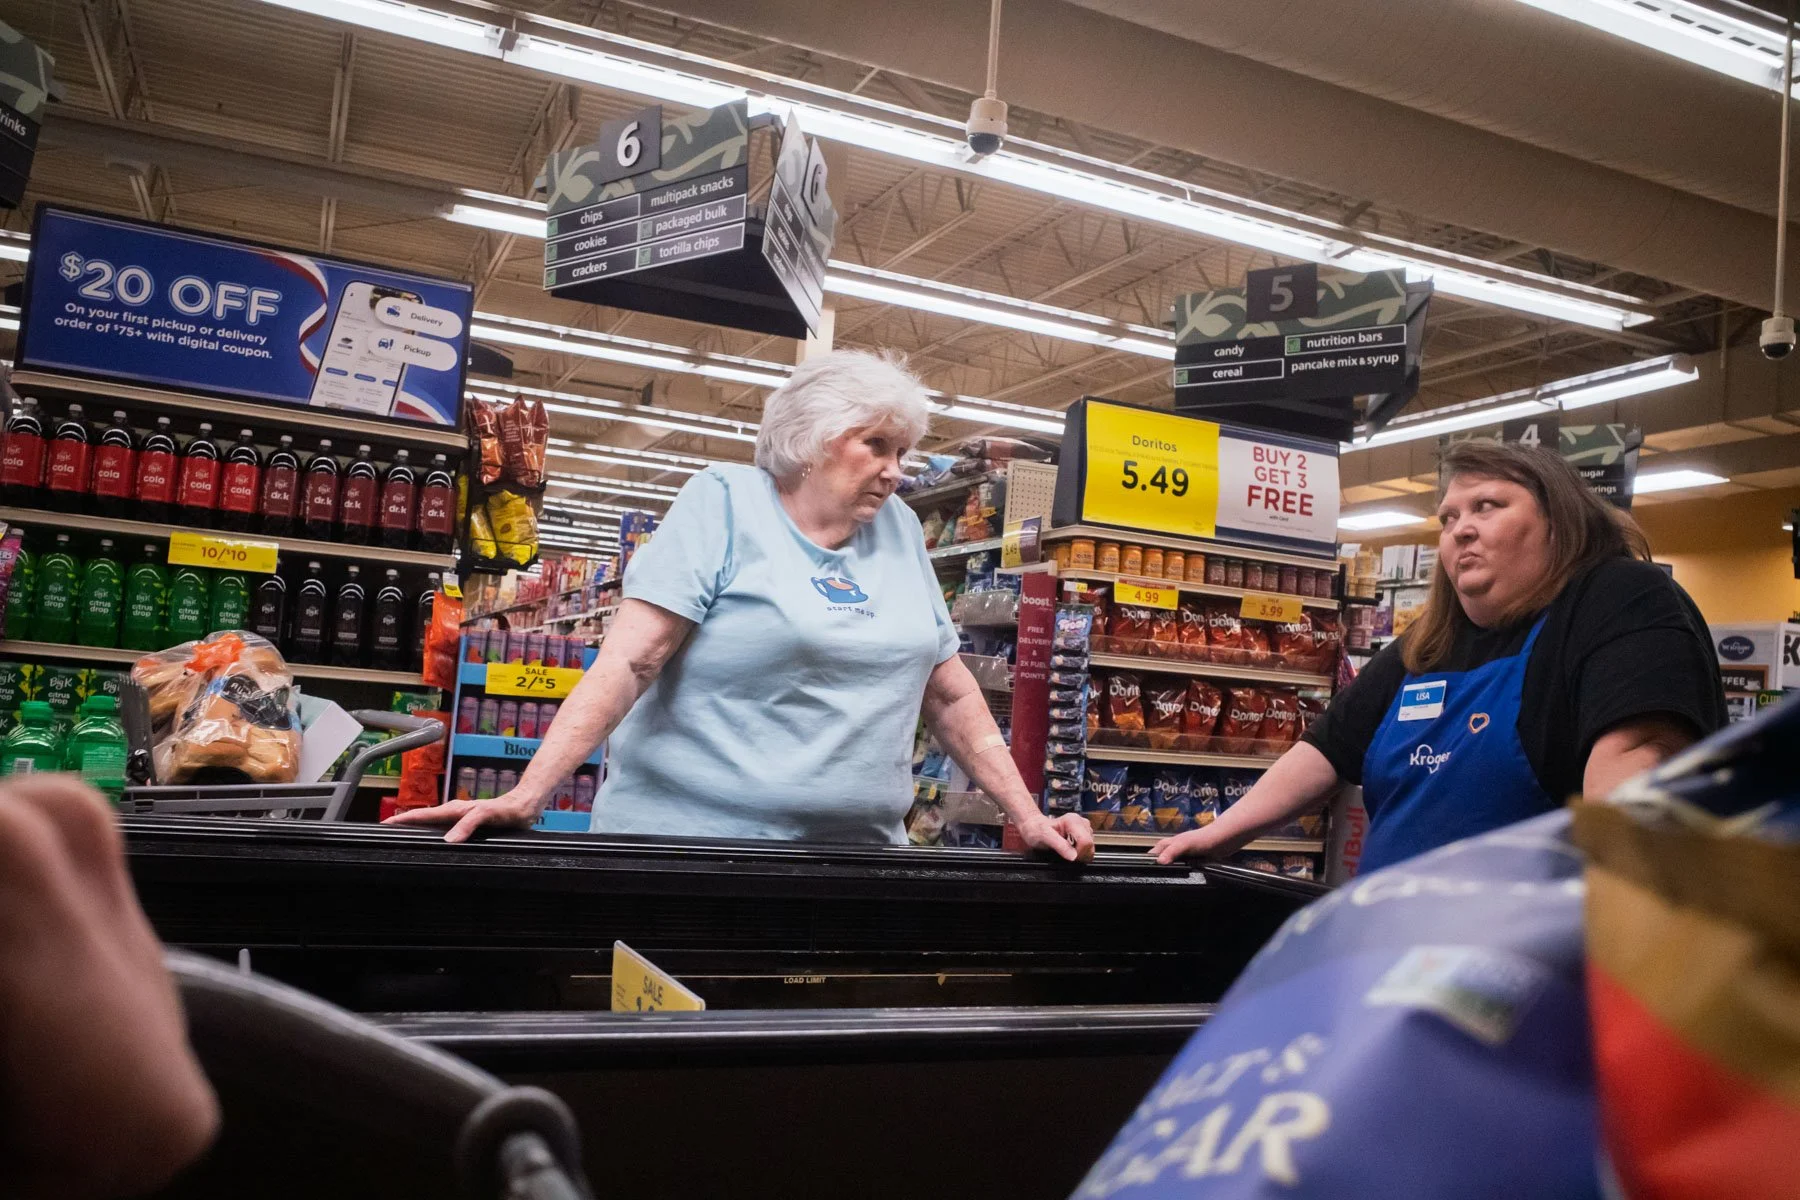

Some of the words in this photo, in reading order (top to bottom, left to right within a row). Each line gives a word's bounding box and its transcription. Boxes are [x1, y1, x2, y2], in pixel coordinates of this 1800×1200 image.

[616, 121, 641, 167] 6
[650, 184, 698, 208] multipack
[700, 175, 734, 196] snacks
[580, 209, 603, 225] chips
[655, 210, 702, 235] packaged
[704, 203, 727, 217] bulk
[574, 233, 607, 252] cookies
[659, 239, 692, 258] tortilla
[693, 235, 720, 251] chips
[571, 260, 608, 278] crackers
[60, 252, 154, 306] $20
[169, 276, 282, 326] OFF
[1269, 275, 1293, 313] 5
[65, 302, 85, 314] On
[88, 307, 119, 320] your
[122, 311, 149, 325] first
[152, 317, 196, 334] pickup
[199, 325, 214, 335] or
[216, 328, 268, 346] delivery
[410, 312, 444, 327] Delivery
[54, 317, 93, 330] order
[95, 323, 110, 333] of
[113, 323, 142, 337] $75+
[146, 331, 175, 344] with
[178, 335, 220, 351] digital
[222, 343, 273, 360] coupon.
[1306, 335, 1355, 349] nutrition
[1357, 330, 1384, 344] bars
[403, 344, 432, 358] Pickup
[1213, 345, 1245, 358] candy
[1290, 358, 1336, 373] pancake
[1337, 357, 1358, 369] mix
[1359, 357, 1366, 366] &
[1366, 352, 1400, 367] syrup
[1212, 366, 1243, 379] cereal
[1519, 424, 1541, 449] 4
[1132, 434, 1178, 453] Doritos
[3, 458, 24, 467] cola
[1253, 445, 1291, 467] BUY
[1297, 454, 1307, 470] 2
[52, 464, 75, 474] cola
[98, 469, 120, 479] cola
[143, 474, 165, 485] cola
[1121, 459, 1189, 498] 5.49
[1254, 466, 1291, 486] GET
[1298, 473, 1307, 489] 3
[190, 480, 212, 491] cola
[231, 486, 251, 496] cola
[270, 491, 290, 502] dr.k
[314, 495, 333, 506] dr.k
[1247, 484, 1314, 517] FREE
[344, 499, 361, 510] dr.k
[389, 504, 408, 515] dr.k
[427, 508, 446, 519] dr.k
[201, 546, 248, 562] 10/$10
[44, 594, 67, 605] citrus
[1134, 591, 1159, 604] 4.99
[44, 601, 65, 609] drop
[89, 600, 112, 610] citrus
[90, 606, 110, 615] drop
[132, 605, 154, 614] citrus
[1260, 604, 1283, 618] 3.99
[132, 610, 153, 619] drop
[178, 608, 200, 616] citrus
[219, 612, 240, 620] citrus
[854, 607, 865, 615] me
[866, 610, 876, 618] up
[220, 618, 238, 626] drop
[1027, 626, 1045, 634] FREE
[1019, 636, 1052, 646] DELIVERY
[1030, 660, 1047, 668] FUEL
[525, 667, 548, 676] SALE
[1020, 672, 1046, 680] POINTS
[515, 676, 556, 690] 2/$5
[1722, 676, 1746, 686] FFEE
[103, 680, 120, 696] Big
[1109, 684, 1141, 697] Dorit
[48, 691, 71, 700] citrus
[1416, 692, 1430, 701] LISA
[504, 741, 536, 756] Bloo
[1409, 744, 1451, 774] Kroger
[783, 976, 804, 984] LOAD
[805, 976, 826, 984] LIMIT
[643, 975, 663, 1006] SALE
